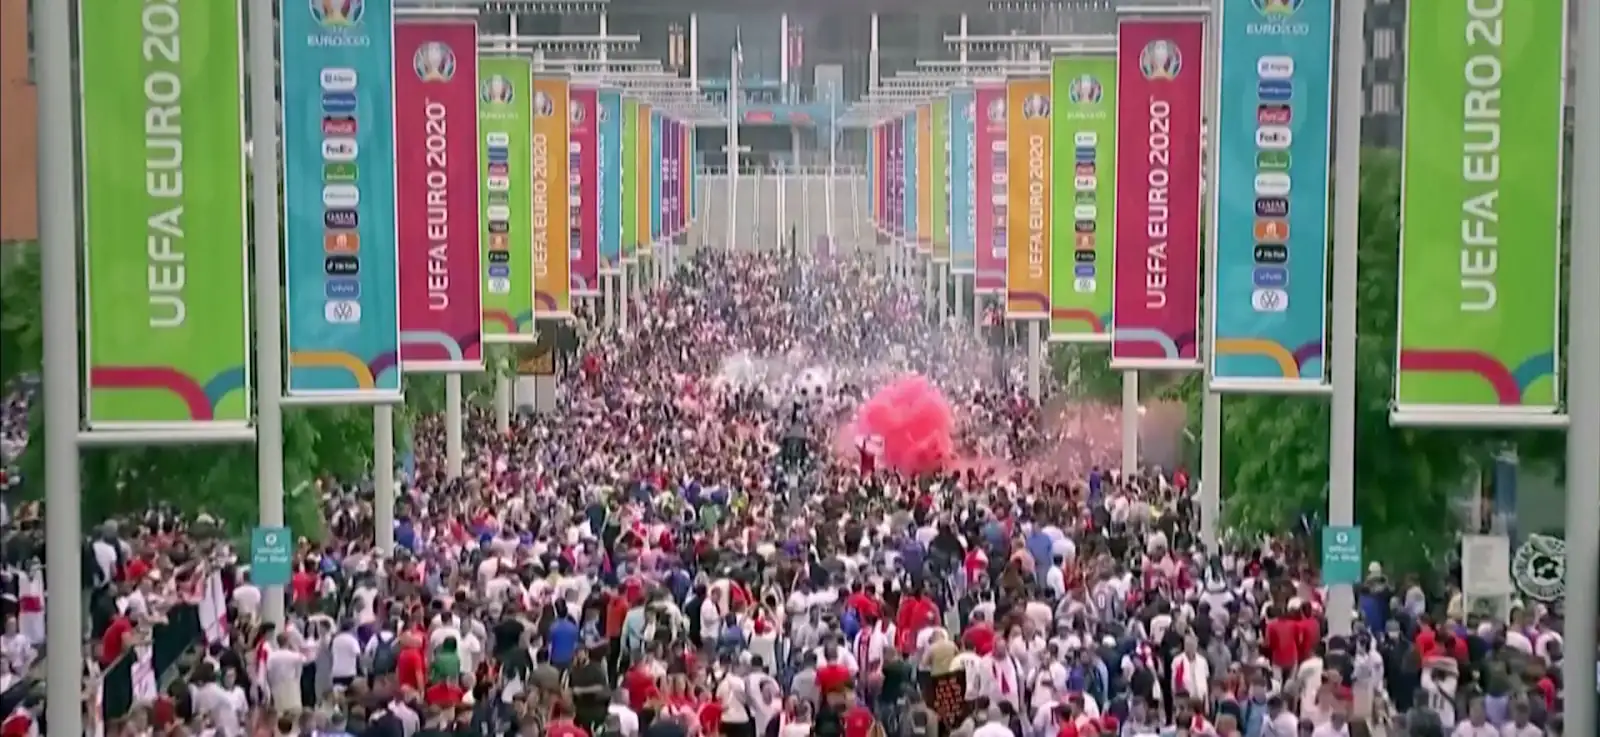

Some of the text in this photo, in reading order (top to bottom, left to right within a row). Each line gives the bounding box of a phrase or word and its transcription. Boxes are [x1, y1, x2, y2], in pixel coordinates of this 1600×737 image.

[142, 0, 187, 328] UEFA EURO 20
[1463, 54, 1502, 182] EURO
[425, 102, 449, 310] UEFA EURO 2020
[533, 133, 548, 278] UEFA EURO 2020
[1029, 134, 1044, 279] UEFA EURO 2020
[1146, 100, 1170, 310] UEFA EURO 2020
[1460, 189, 1499, 311] UEFA
